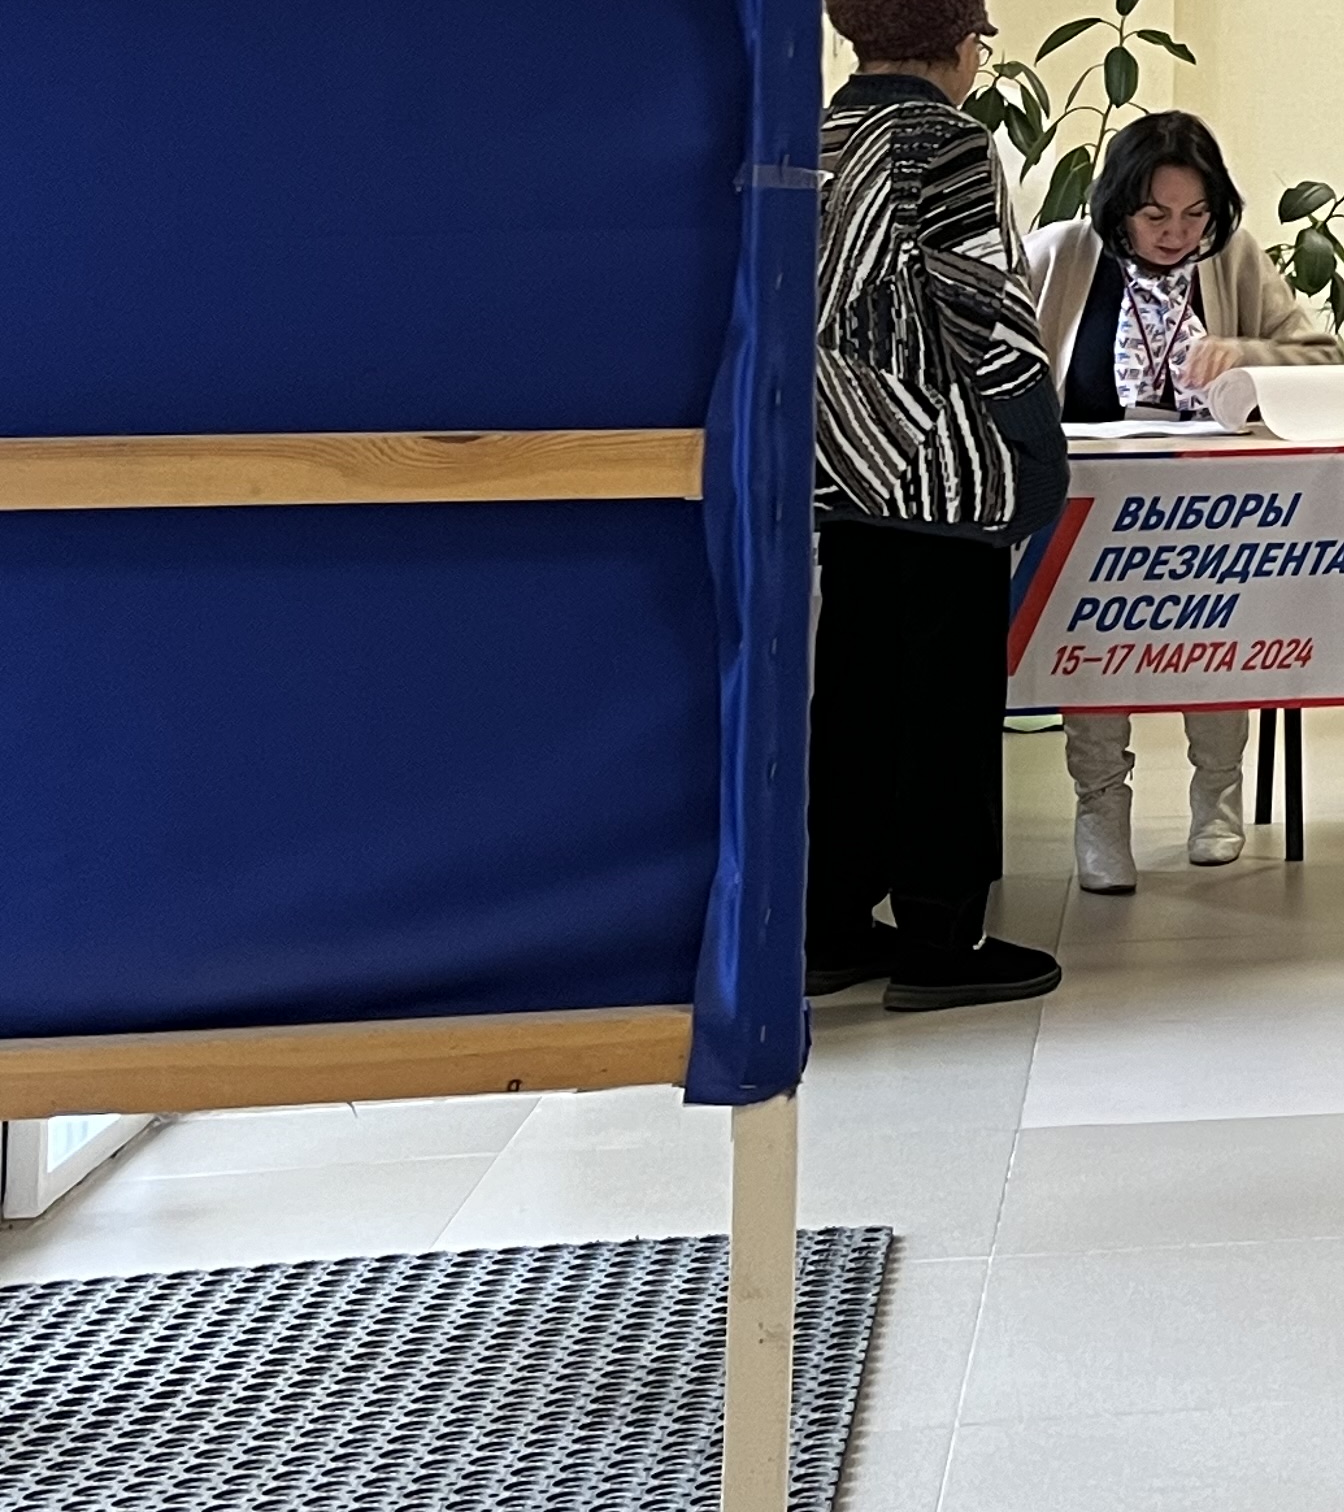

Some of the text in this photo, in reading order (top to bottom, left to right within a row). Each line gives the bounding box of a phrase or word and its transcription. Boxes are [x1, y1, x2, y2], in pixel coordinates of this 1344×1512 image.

[1112, 492, 1302, 533] ВЫБОРЫ
[1066, 593, 1240, 633] РОССИИ
[1134, 641, 1238, 675] МАРТА
[1241, 637, 1313, 672] 2024
